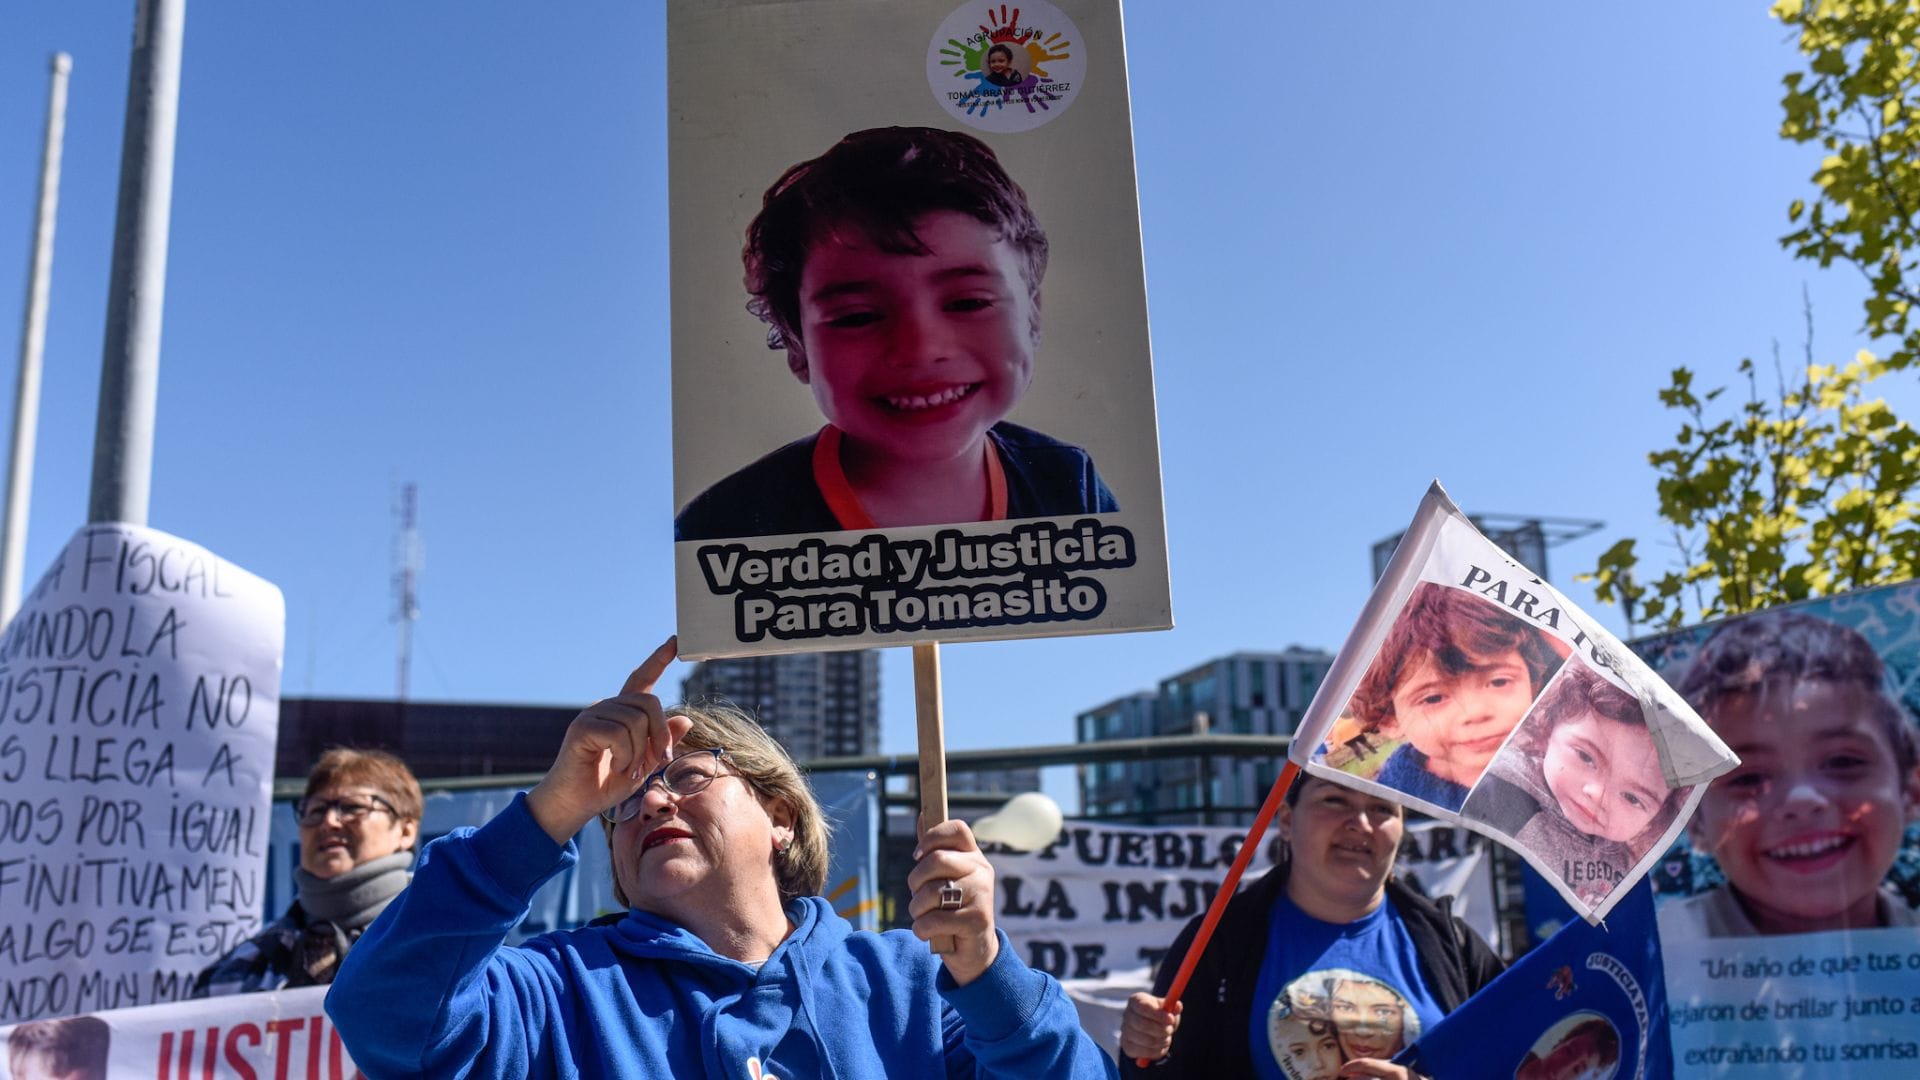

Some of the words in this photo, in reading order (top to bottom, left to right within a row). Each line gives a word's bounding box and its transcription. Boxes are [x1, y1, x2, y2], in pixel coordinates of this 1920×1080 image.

[966, 27, 1043, 46] AGRUPACIÓN
[81, 528, 233, 598] FISCAL
[704, 541, 883, 589] Verdad
[895, 546, 924, 581] y
[935, 526, 1128, 572] Justicia
[742, 594, 858, 635] Para
[869, 579, 1099, 626] Tomasito
[1460, 564, 1561, 630] PARA
[186, 674, 251, 732] NO
[45, 735, 174, 786] LLEGA
[203, 743, 242, 786] A
[76, 796, 145, 848] POR
[170, 793, 260, 856] IGUAL
[1001, 876, 1077, 920] LA
[105, 915, 155, 954] SE
[1027, 939, 1108, 979] DE
[1742, 955, 1783, 979] año
[1788, 954, 1815, 976] de
[1820, 955, 1861, 978] que
[1867, 951, 1902, 972] tus
[1668, 998, 1735, 1029] ejaron
[1740, 1001, 1768, 1022] de
[1774, 1000, 1835, 1020] brillar
[1842, 995, 1905, 1022] junto
[1684, 1043, 1808, 1066] extrañando
[1813, 1044, 1835, 1062] tu
[1840, 1037, 1918, 1062] sonrisa
